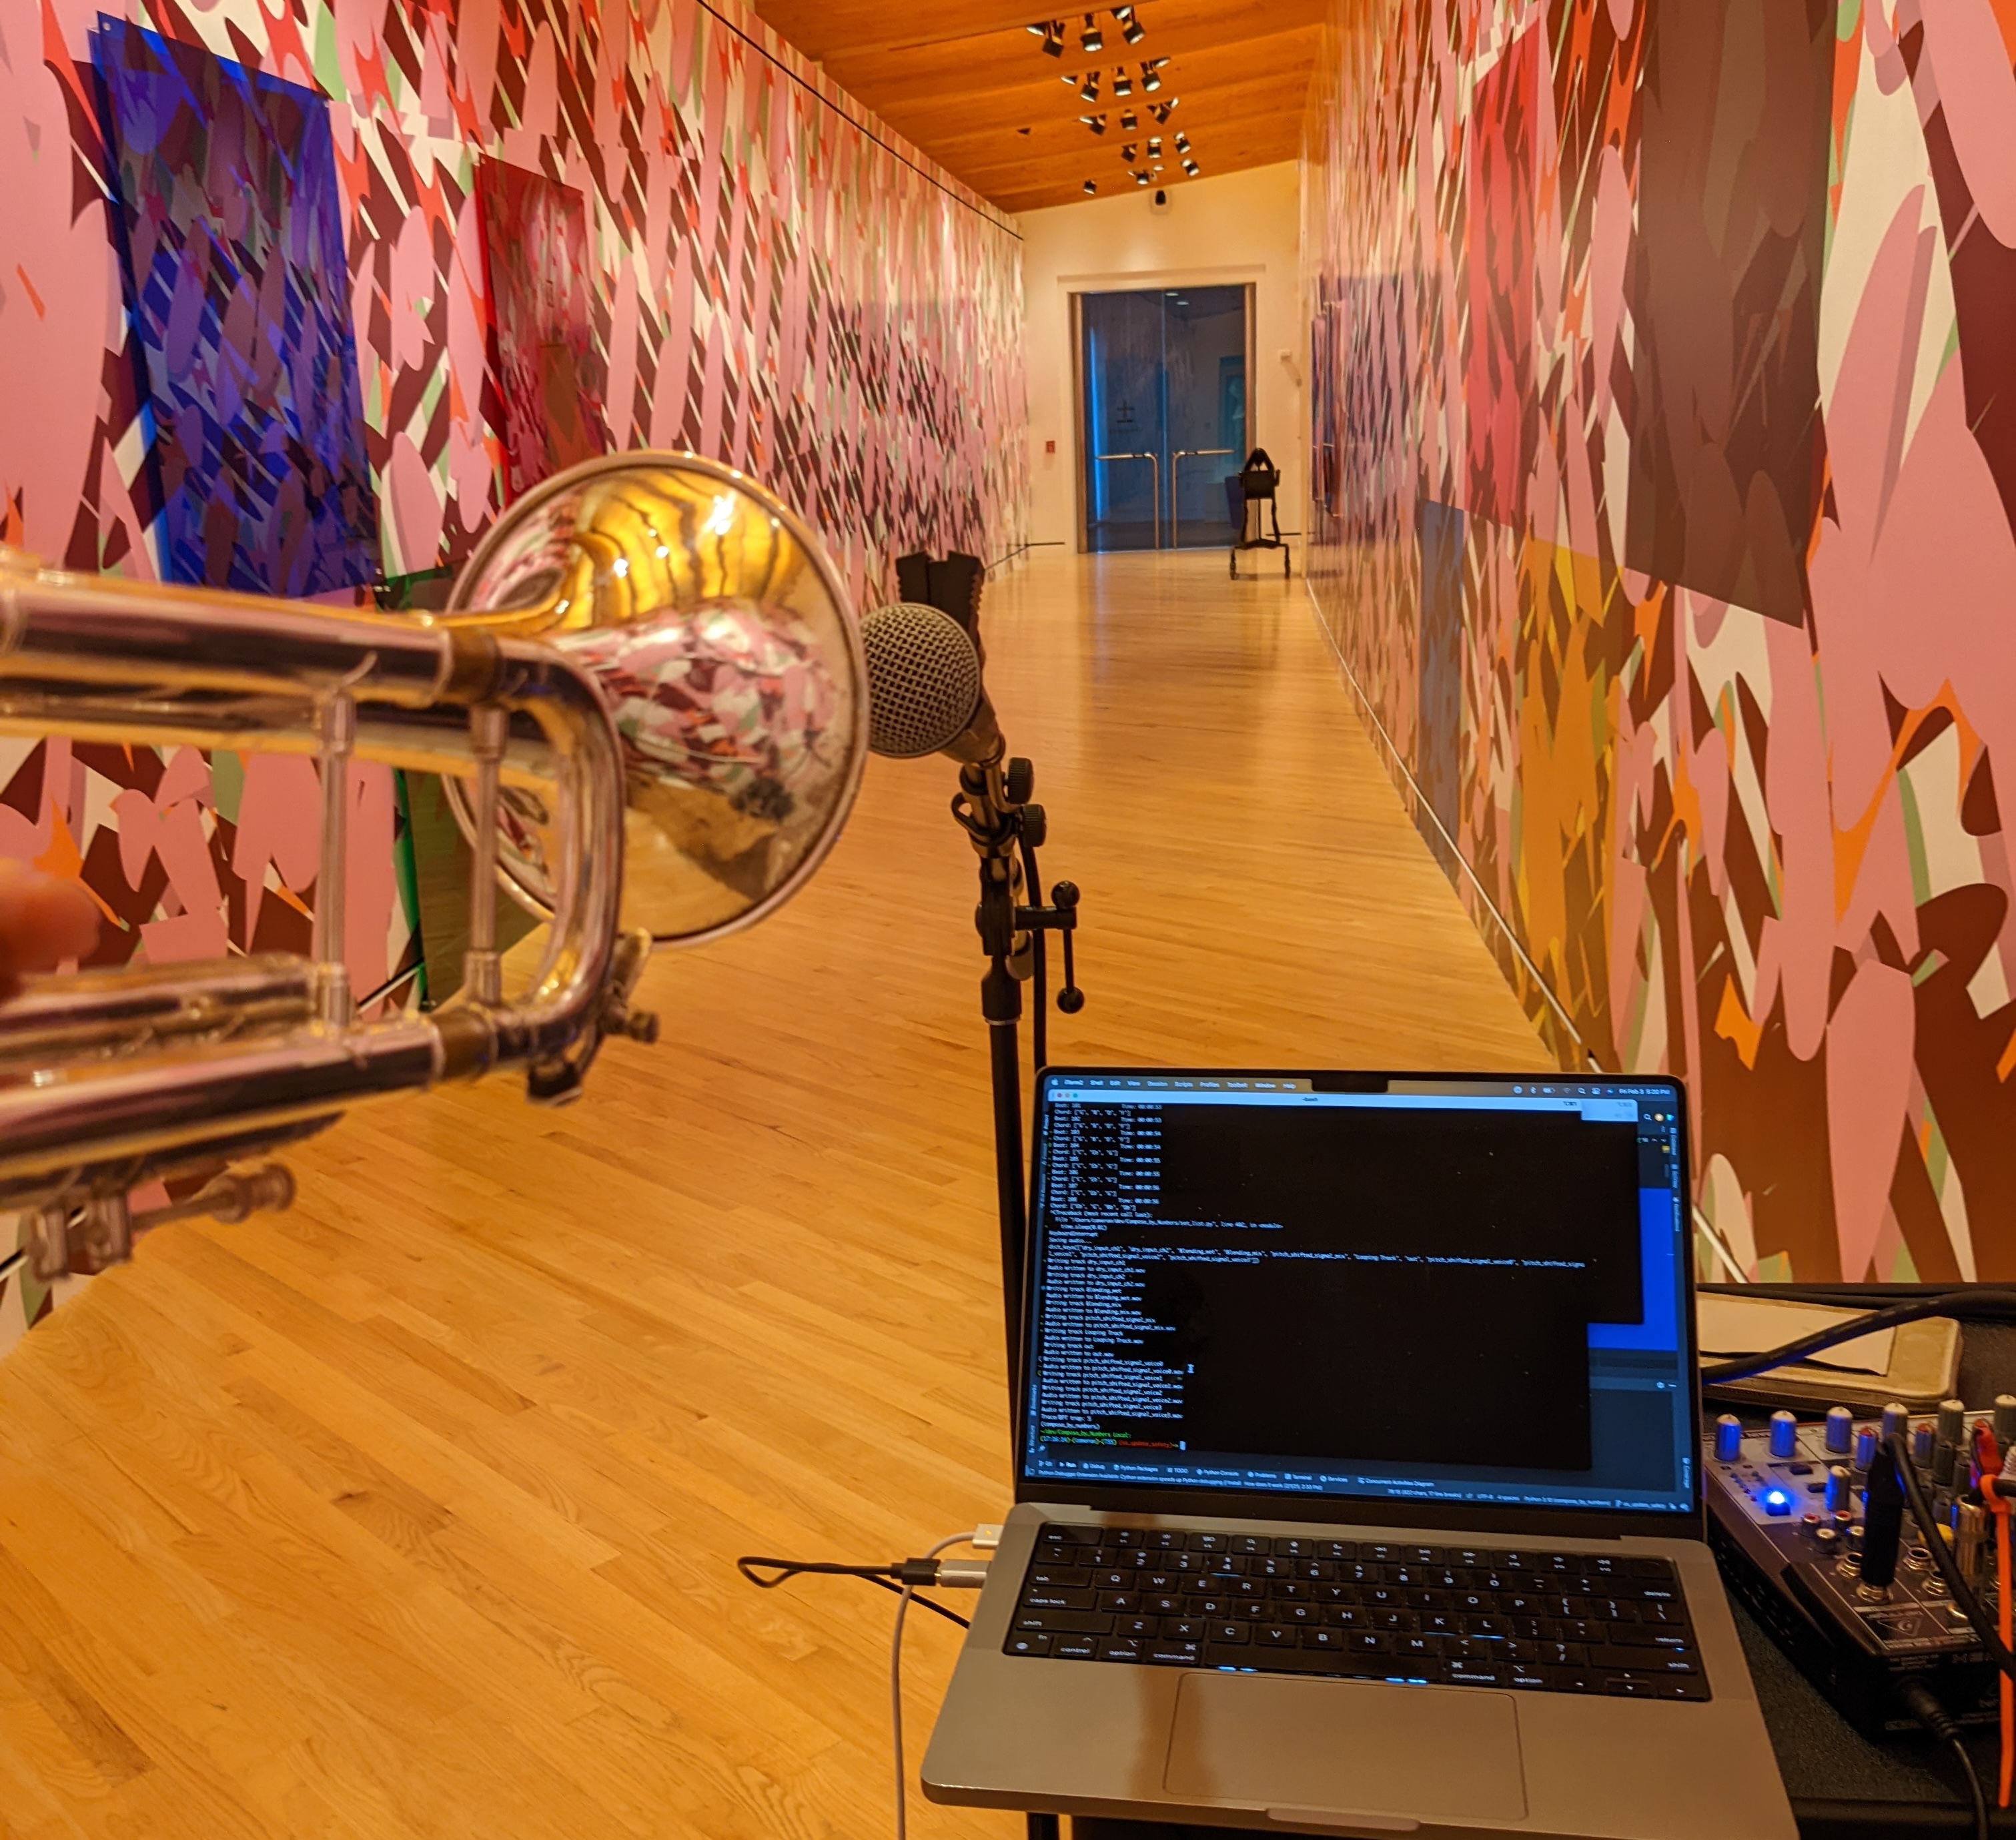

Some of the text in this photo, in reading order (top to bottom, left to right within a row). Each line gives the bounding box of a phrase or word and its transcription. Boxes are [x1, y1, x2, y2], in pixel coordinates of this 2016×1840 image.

[1134, 1621, 1143, 1629] Z
[1435, 1617, 1444, 1625] K
[1482, 1620, 1492, 1628] L
[1225, 1627, 1235, 1635] C
[1318, 1633, 1328, 1641] B
[1411, 1639, 1424, 1647] M
